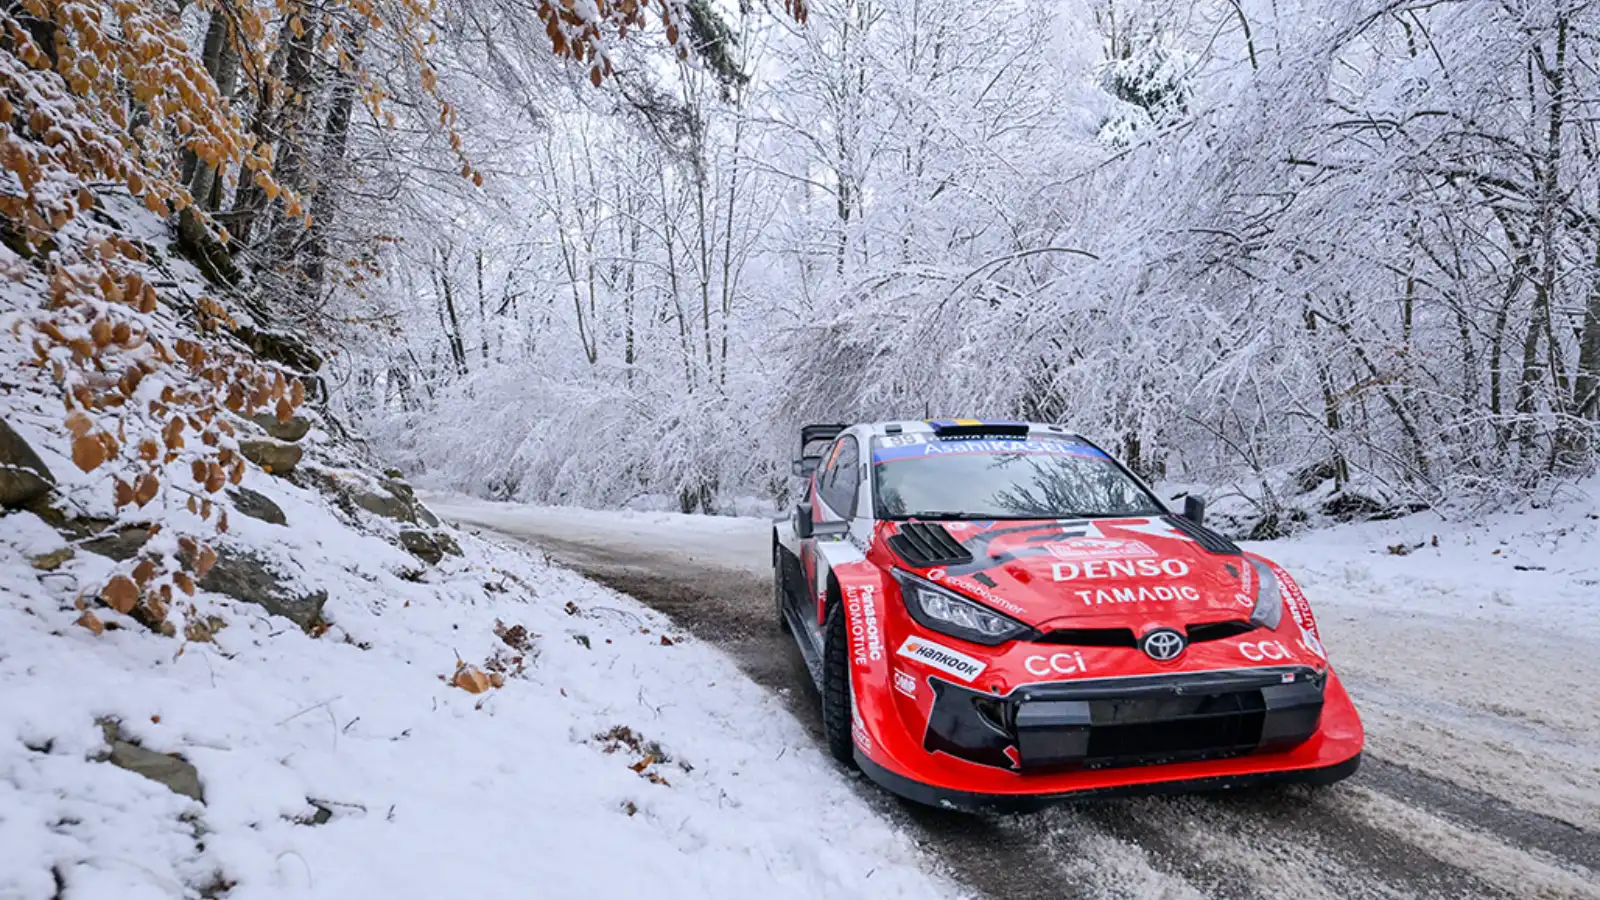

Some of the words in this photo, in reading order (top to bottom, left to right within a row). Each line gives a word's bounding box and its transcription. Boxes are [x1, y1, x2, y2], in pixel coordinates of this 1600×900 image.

[1051, 559, 1190, 581] DENSO
[1075, 586, 1200, 606] TAMADIC
[846, 584, 867, 665] AUTOMOTIVE
[860, 584, 884, 661] Panasonic
[1025, 651, 1087, 676] CCi
